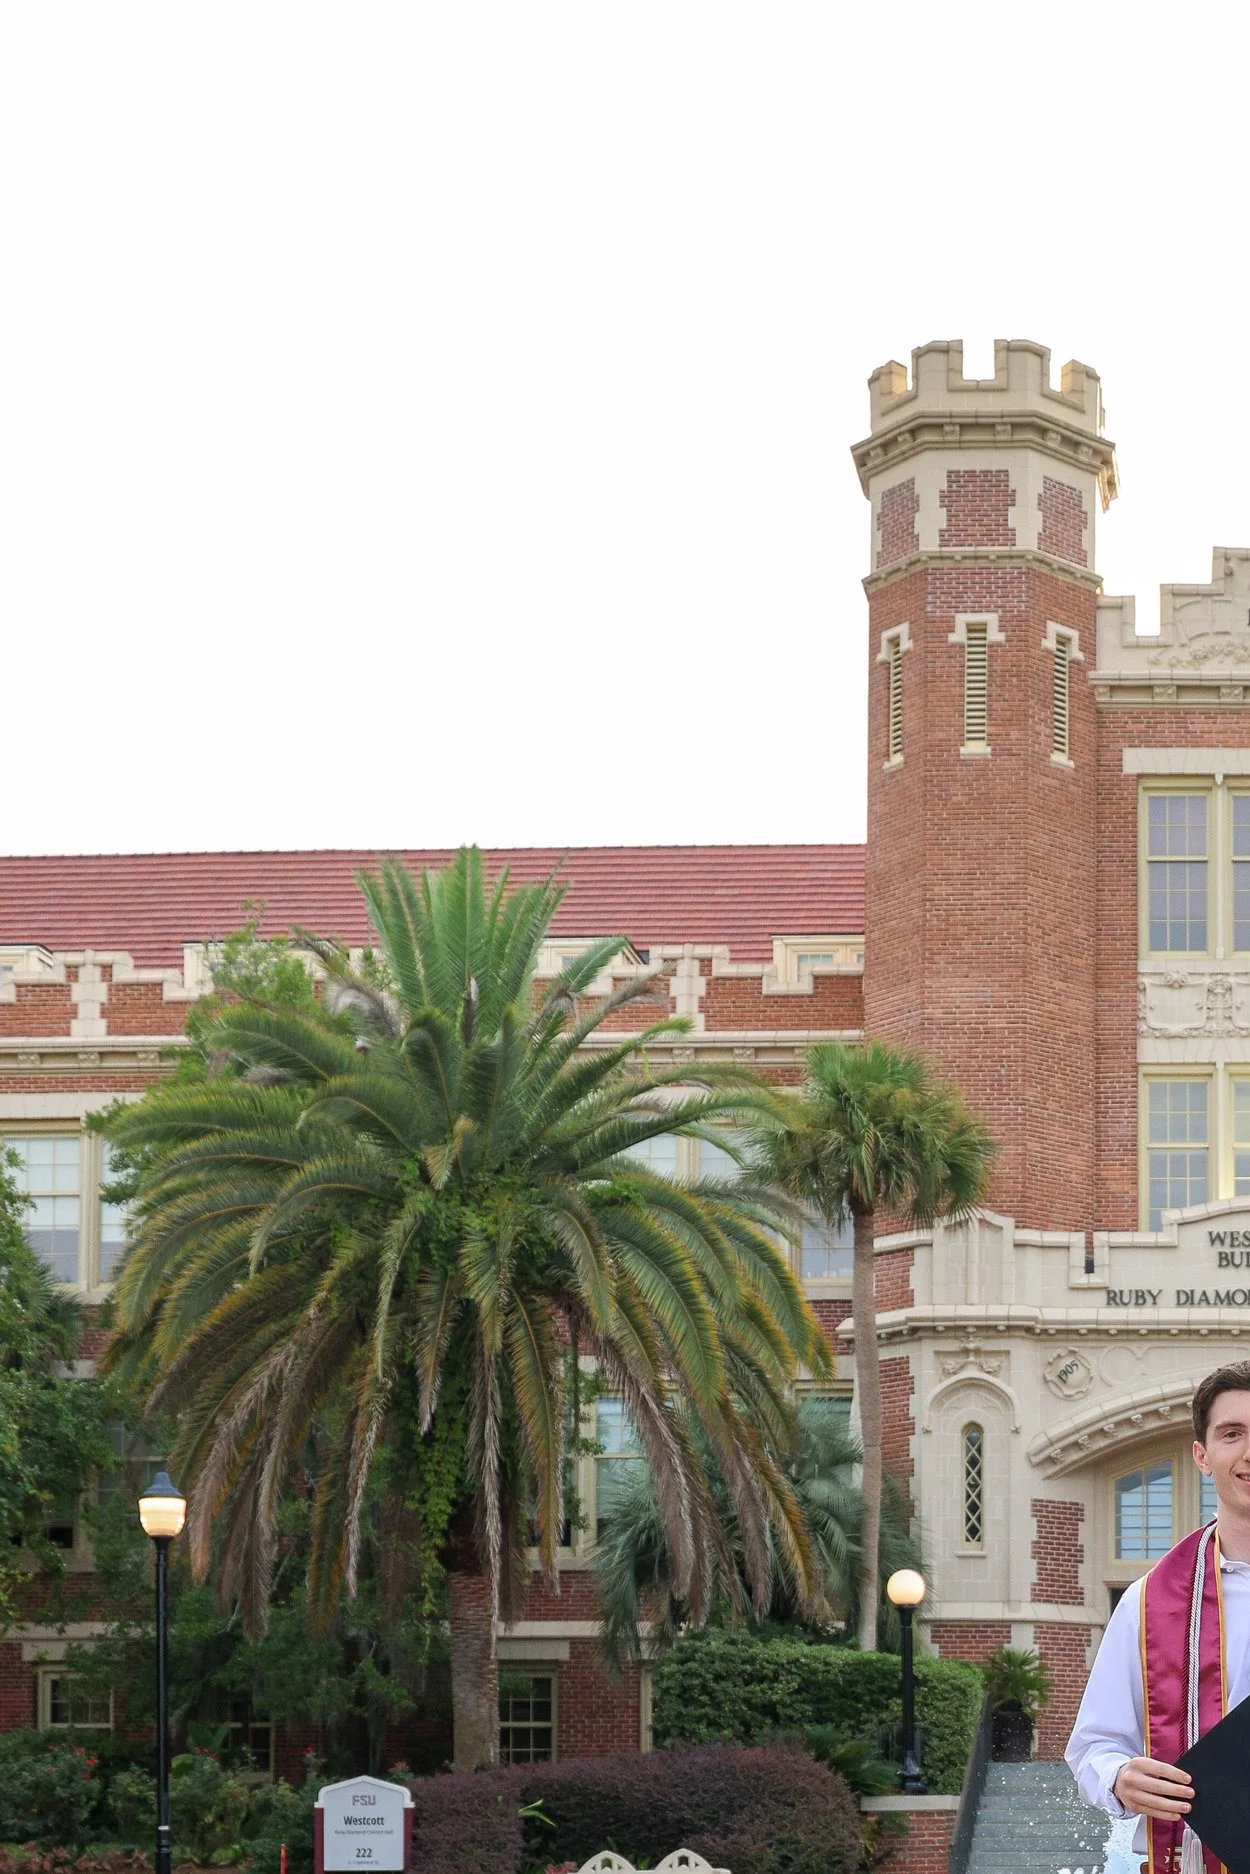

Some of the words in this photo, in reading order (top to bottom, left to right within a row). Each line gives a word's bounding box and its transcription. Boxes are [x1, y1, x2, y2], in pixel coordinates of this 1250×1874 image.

[1106, 1289, 1163, 1306] RUBY
[1057, 1359, 1079, 1384] 1905
[352, 1795, 376, 1806] FSU
[343, 1816, 385, 1826] Westcott
[355, 1848, 373, 1858] 222
